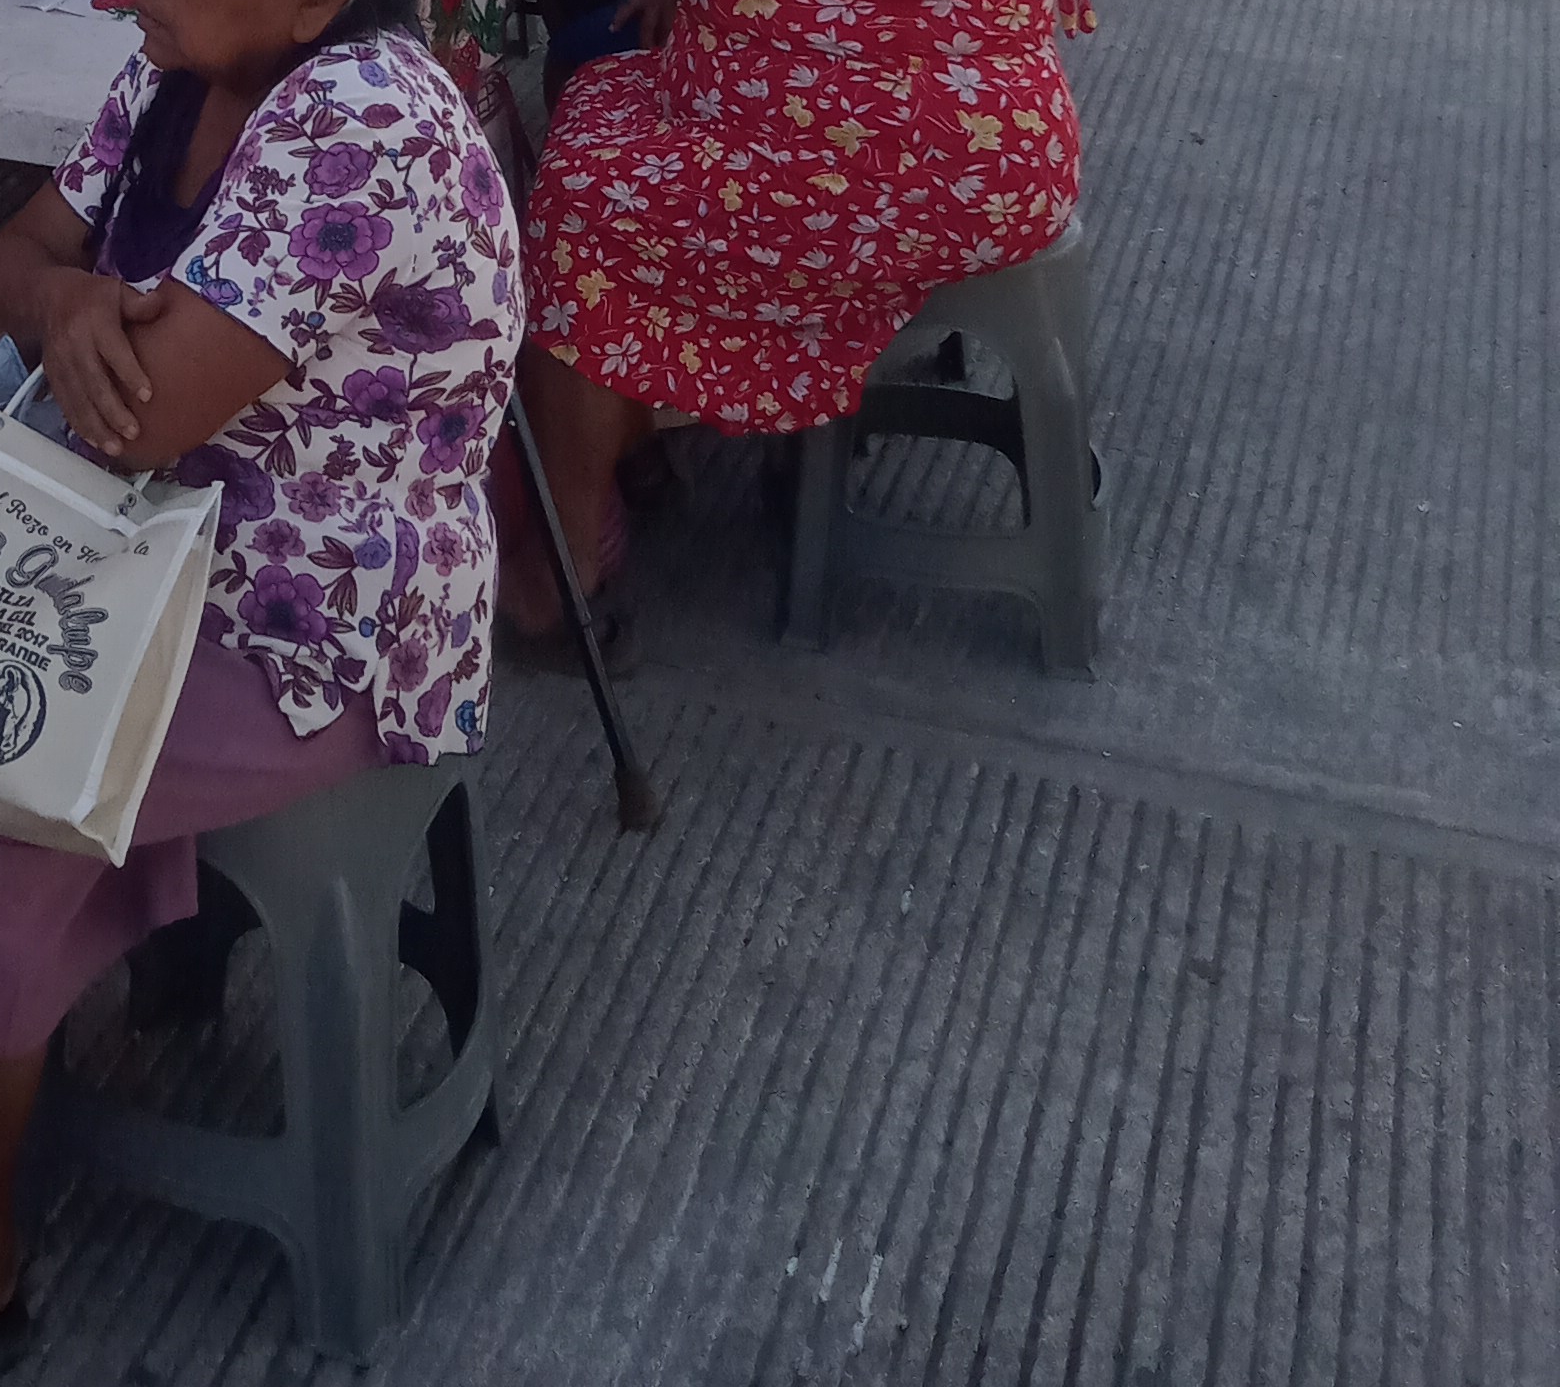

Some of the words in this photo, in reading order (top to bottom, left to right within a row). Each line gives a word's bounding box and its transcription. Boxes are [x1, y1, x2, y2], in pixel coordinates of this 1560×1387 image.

[6, 497, 50, 537] Rezo
[52, 533, 74, 555] en
[6, 609, 37, 628] GIL
[16, 625, 51, 649] 2017
